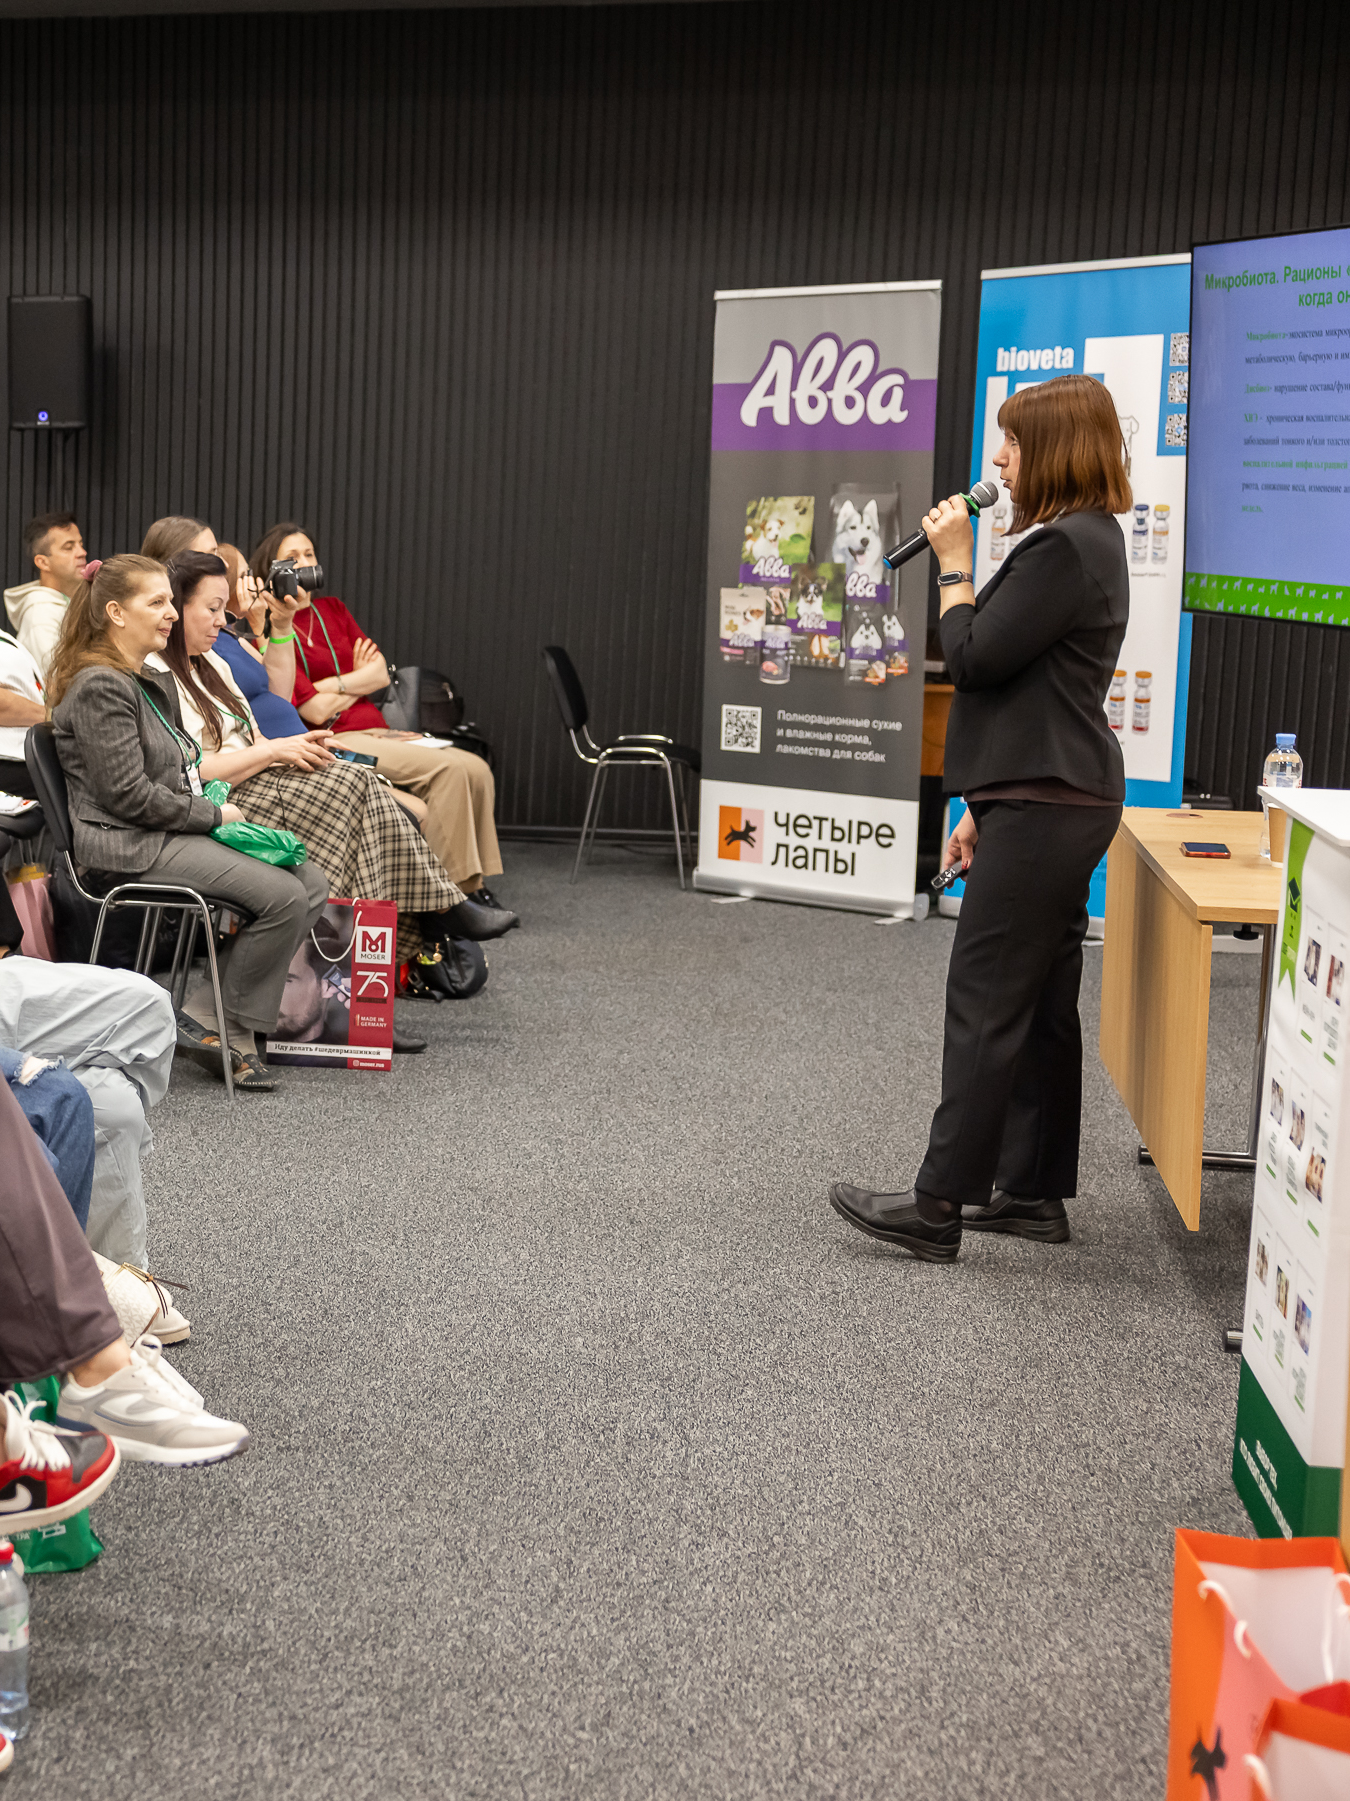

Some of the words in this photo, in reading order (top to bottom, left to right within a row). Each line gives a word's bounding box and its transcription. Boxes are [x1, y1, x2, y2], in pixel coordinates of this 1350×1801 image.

[1205, 269, 1279, 292] Микробиота.
[1283, 265, 1342, 284] Рационы
[1298, 291, 1333, 308] когда
[996, 345, 1075, 372] bioveta
[777, 709, 871, 729] Полнорационные
[871, 719, 903, 732] сухие
[776, 727, 783, 737] и
[785, 728, 833, 742] влажные
[835, 733, 872, 746] корма,
[775, 743, 831, 758] лакомства
[832, 748, 853, 760] для
[854, 750, 886, 763] собак
[360, 953, 386, 961] MOSER
[356, 970, 389, 998] 75
[274, 1043, 288, 1052] Иду
[289, 1045, 313, 1053] делать
